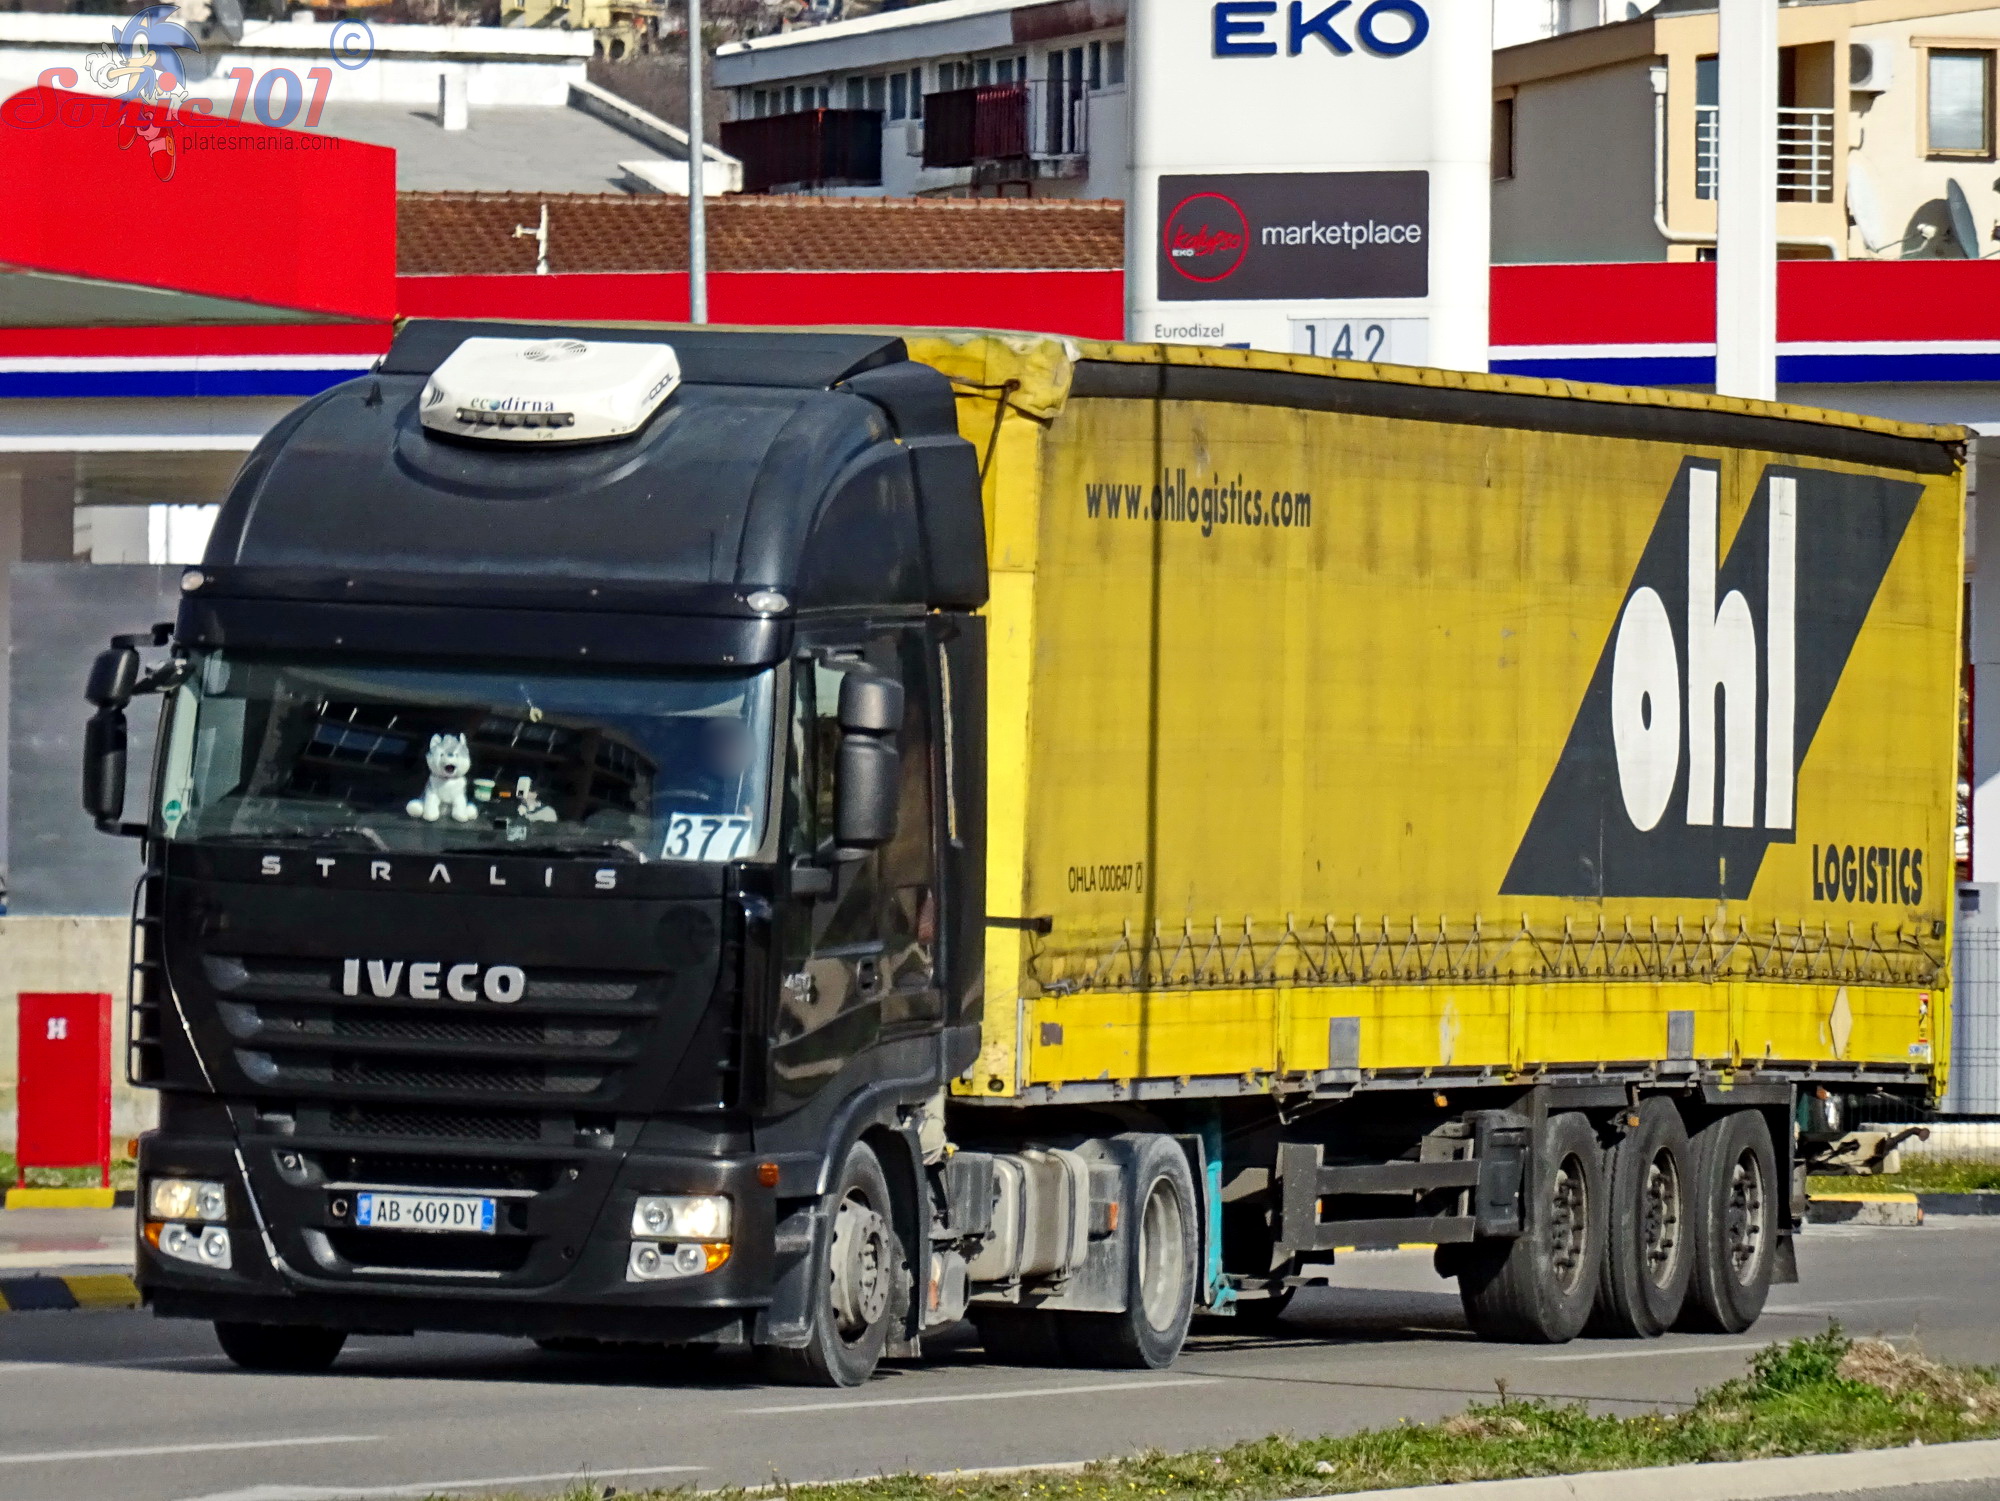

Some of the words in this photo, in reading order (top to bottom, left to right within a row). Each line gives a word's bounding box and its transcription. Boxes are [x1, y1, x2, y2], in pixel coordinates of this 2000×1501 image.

[1214, 0, 1430, 57] EKO
[1172, 248, 1195, 257] EKO
[1261, 220, 1422, 250] marketplace
[1154, 323, 1224, 339] Eurodizel
[1305, 323, 1386, 362] 142
[1085, 467, 1312, 538] www.ohllogistics.com
[1611, 467, 1797, 832] ohl
[666, 818, 752, 861] 377
[260, 855, 620, 890] STRALIS
[1068, 866, 1096, 893] OHLA
[1812, 843, 1924, 907] LOGISTICS
[342, 958, 527, 1003] IVECO
